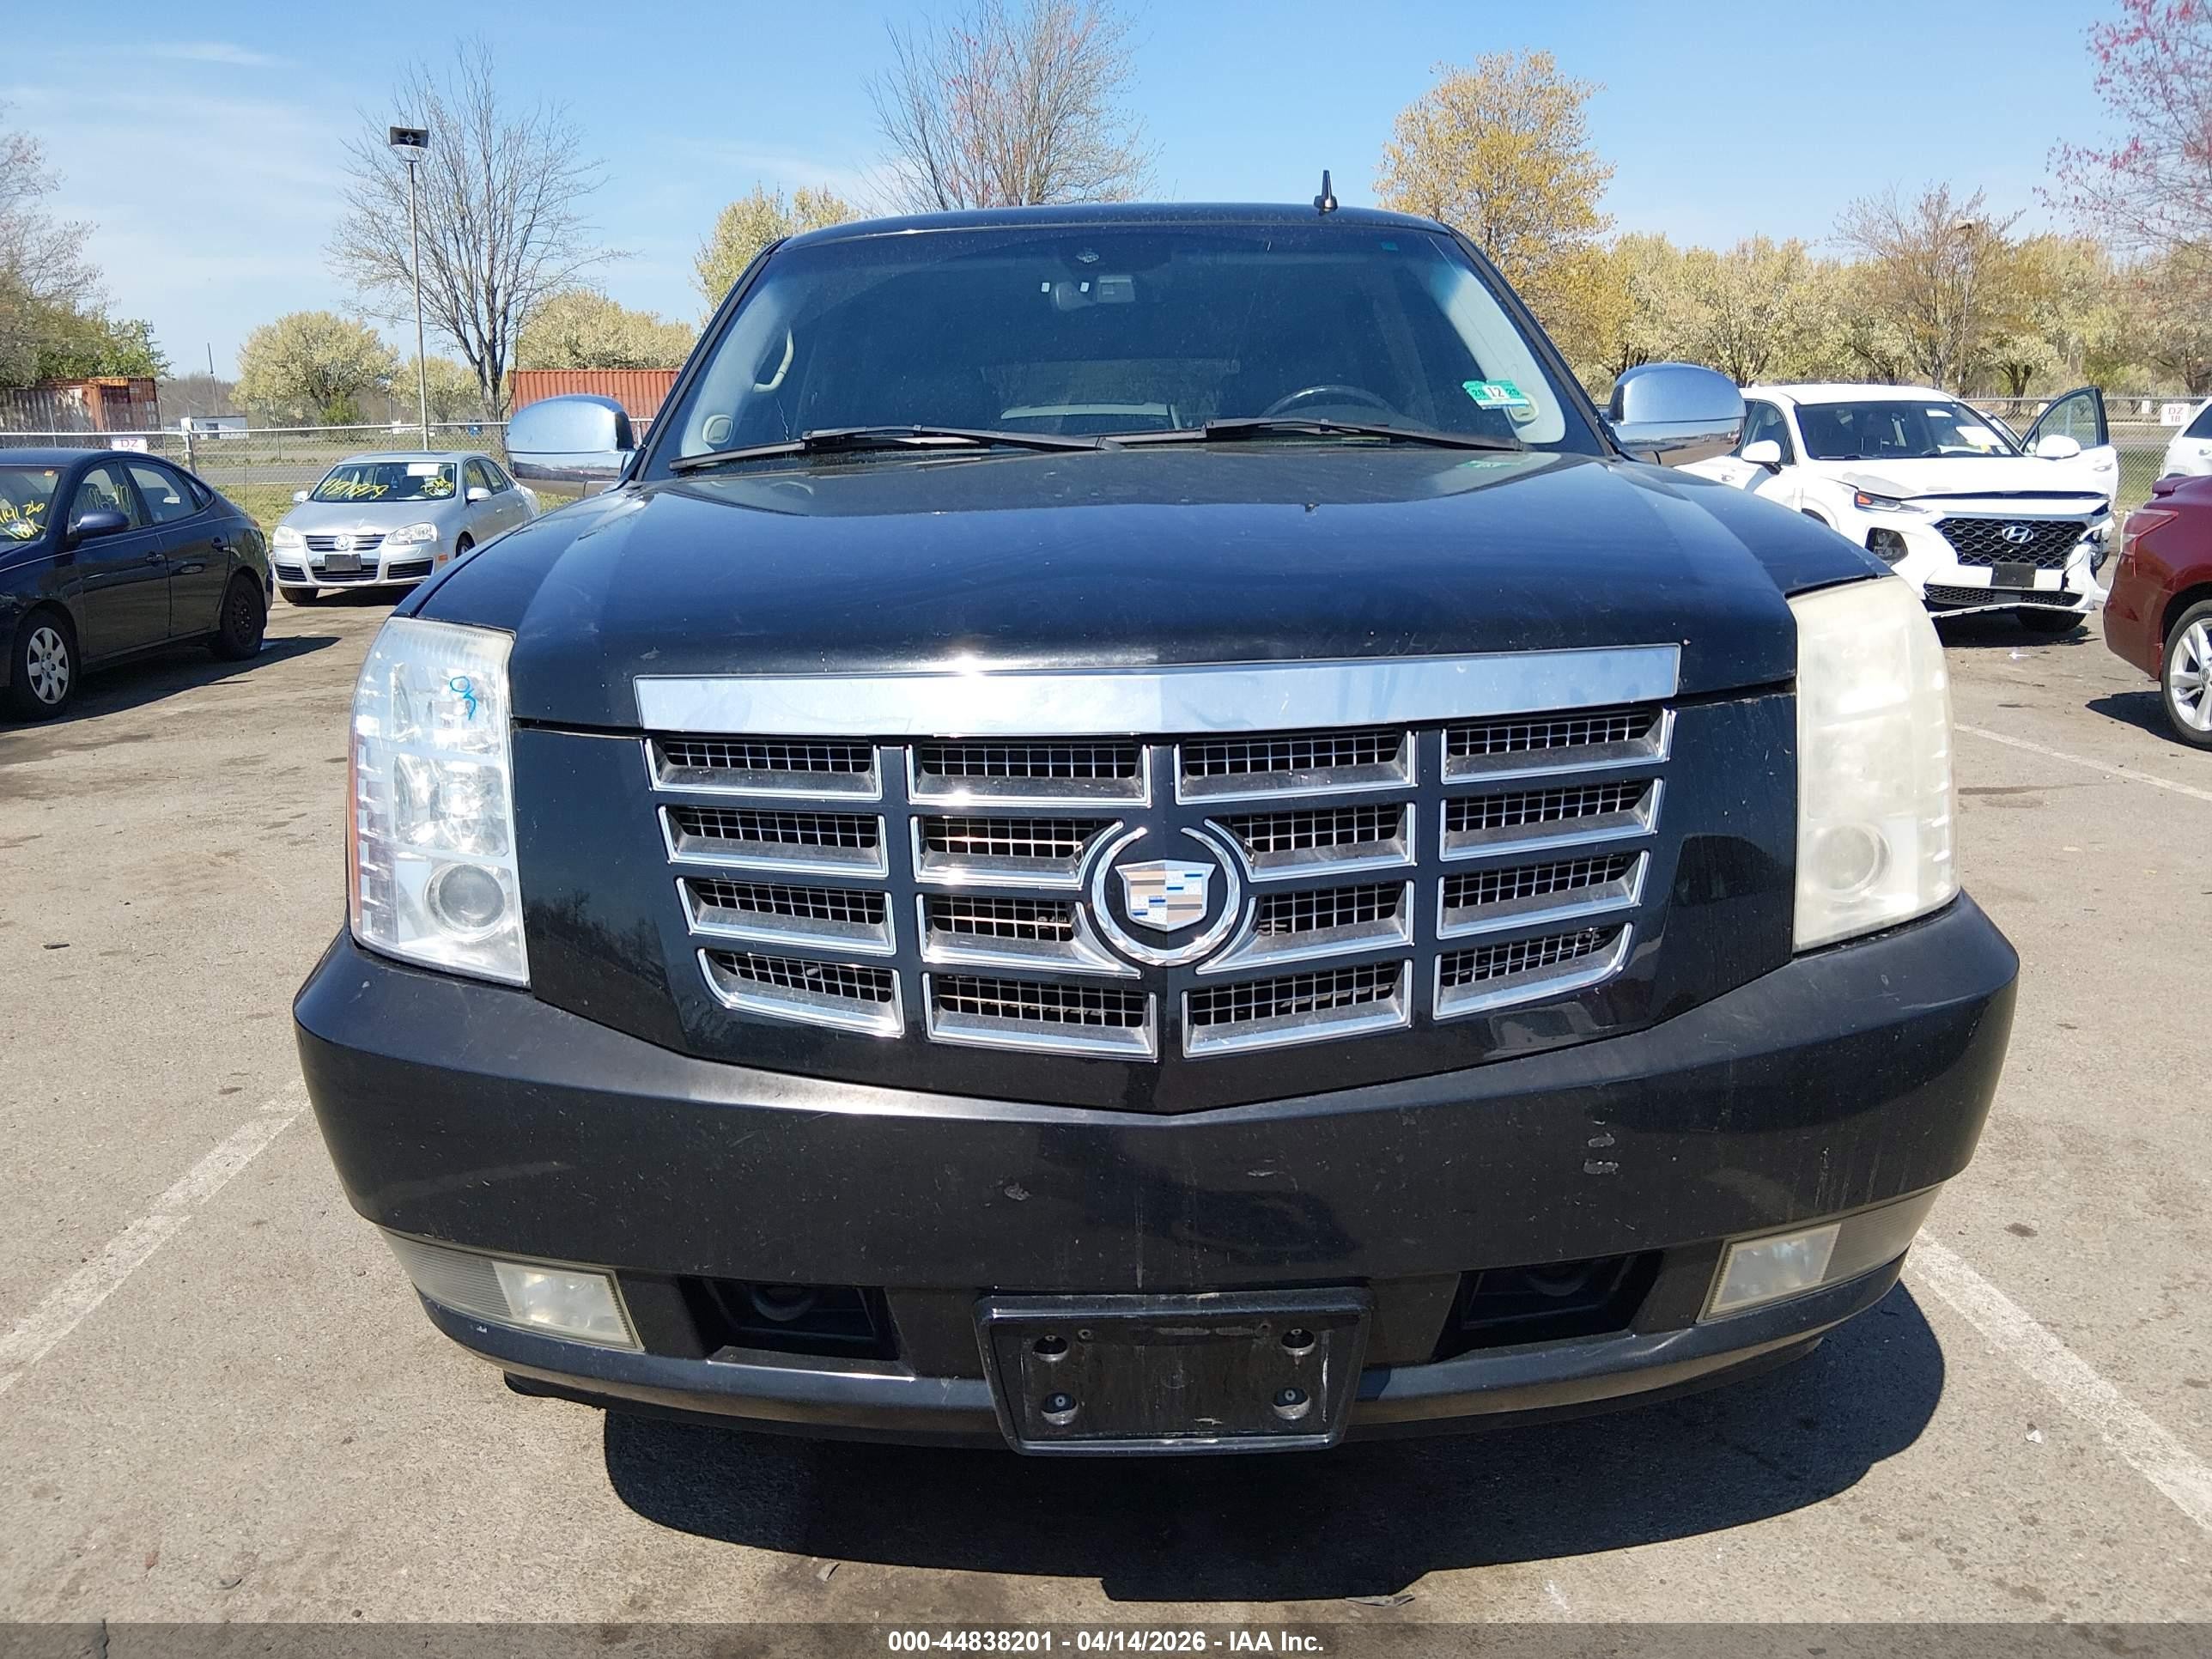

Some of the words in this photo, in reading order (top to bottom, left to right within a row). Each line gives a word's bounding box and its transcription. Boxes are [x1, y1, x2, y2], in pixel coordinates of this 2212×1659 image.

[1487, 386, 1504, 398] 12
[2168, 407, 2184, 416] DZ
[120, 439, 138, 447] DZ
